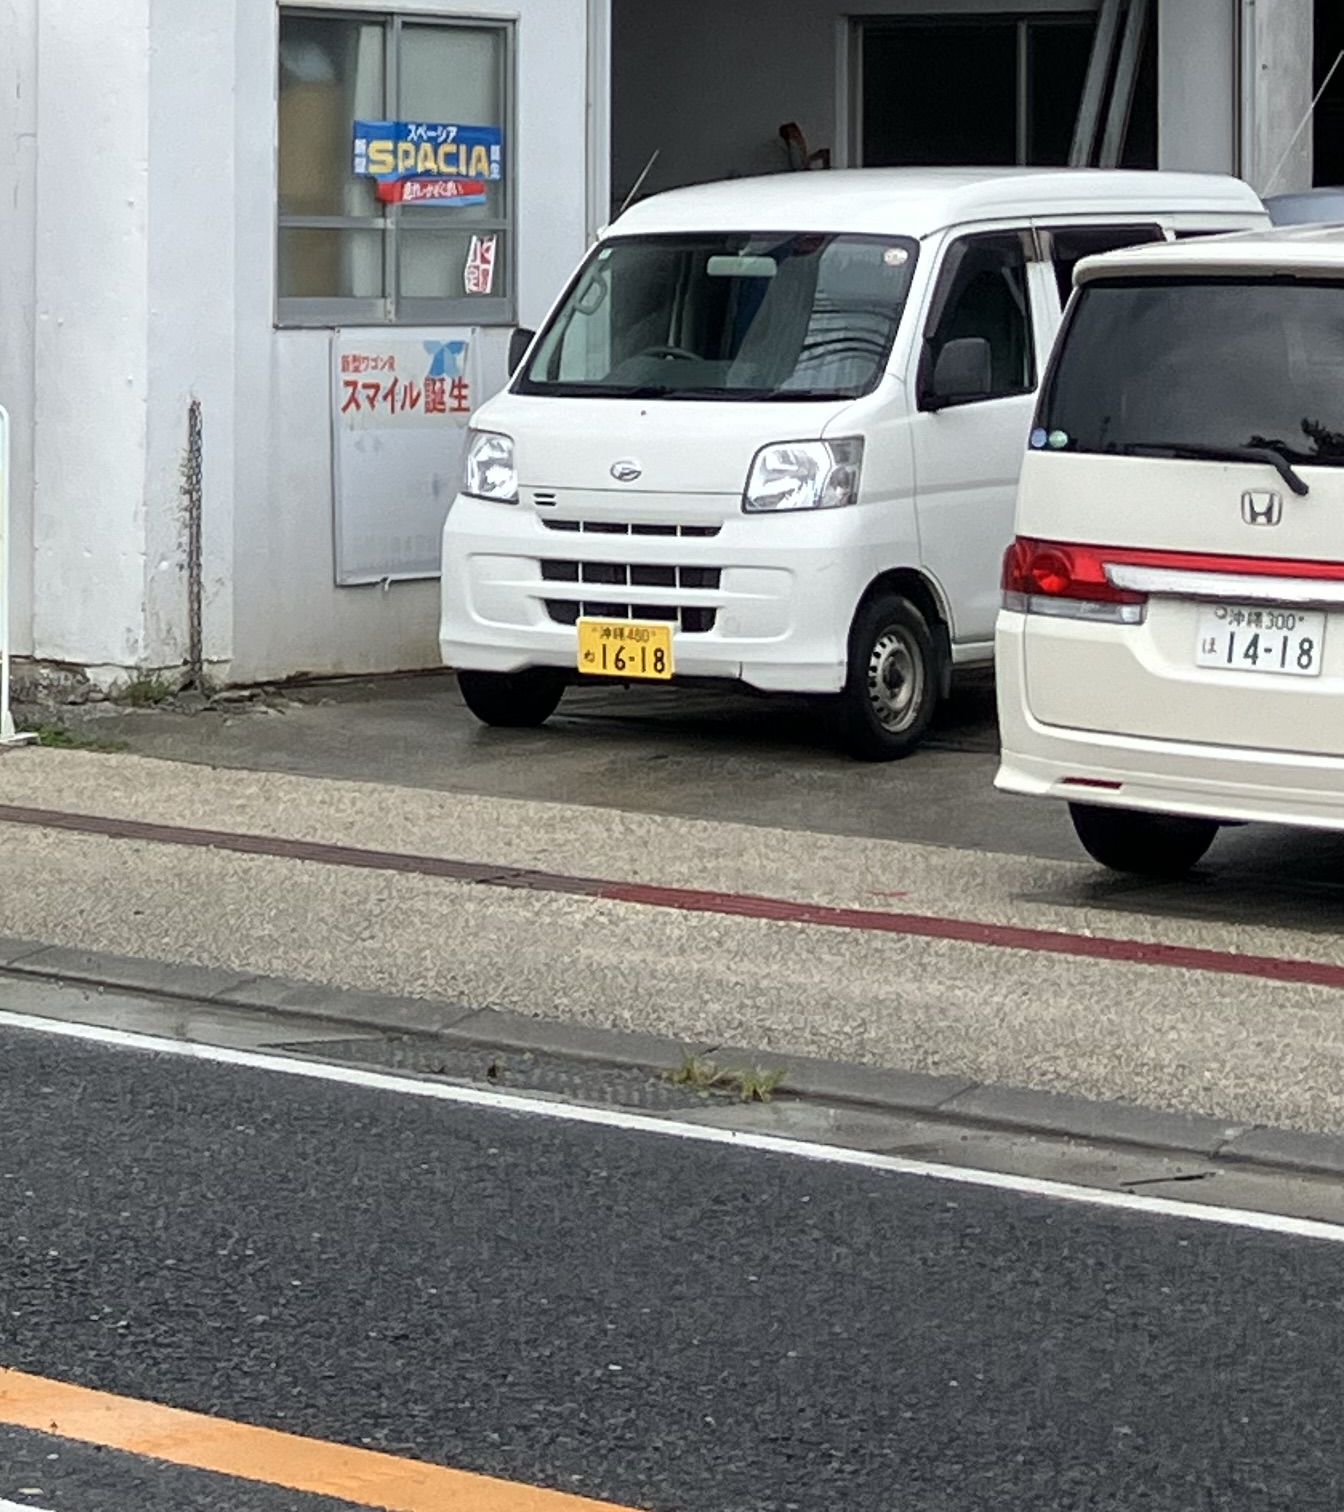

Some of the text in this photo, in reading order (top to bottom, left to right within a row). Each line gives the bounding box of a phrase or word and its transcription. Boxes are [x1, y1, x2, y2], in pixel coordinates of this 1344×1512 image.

[367, 140, 490, 178] SPACIA
[340, 375, 471, 415] スマイル誕生
[602, 643, 665, 674] 16-18
[1226, 631, 1315, 670] 14-18
